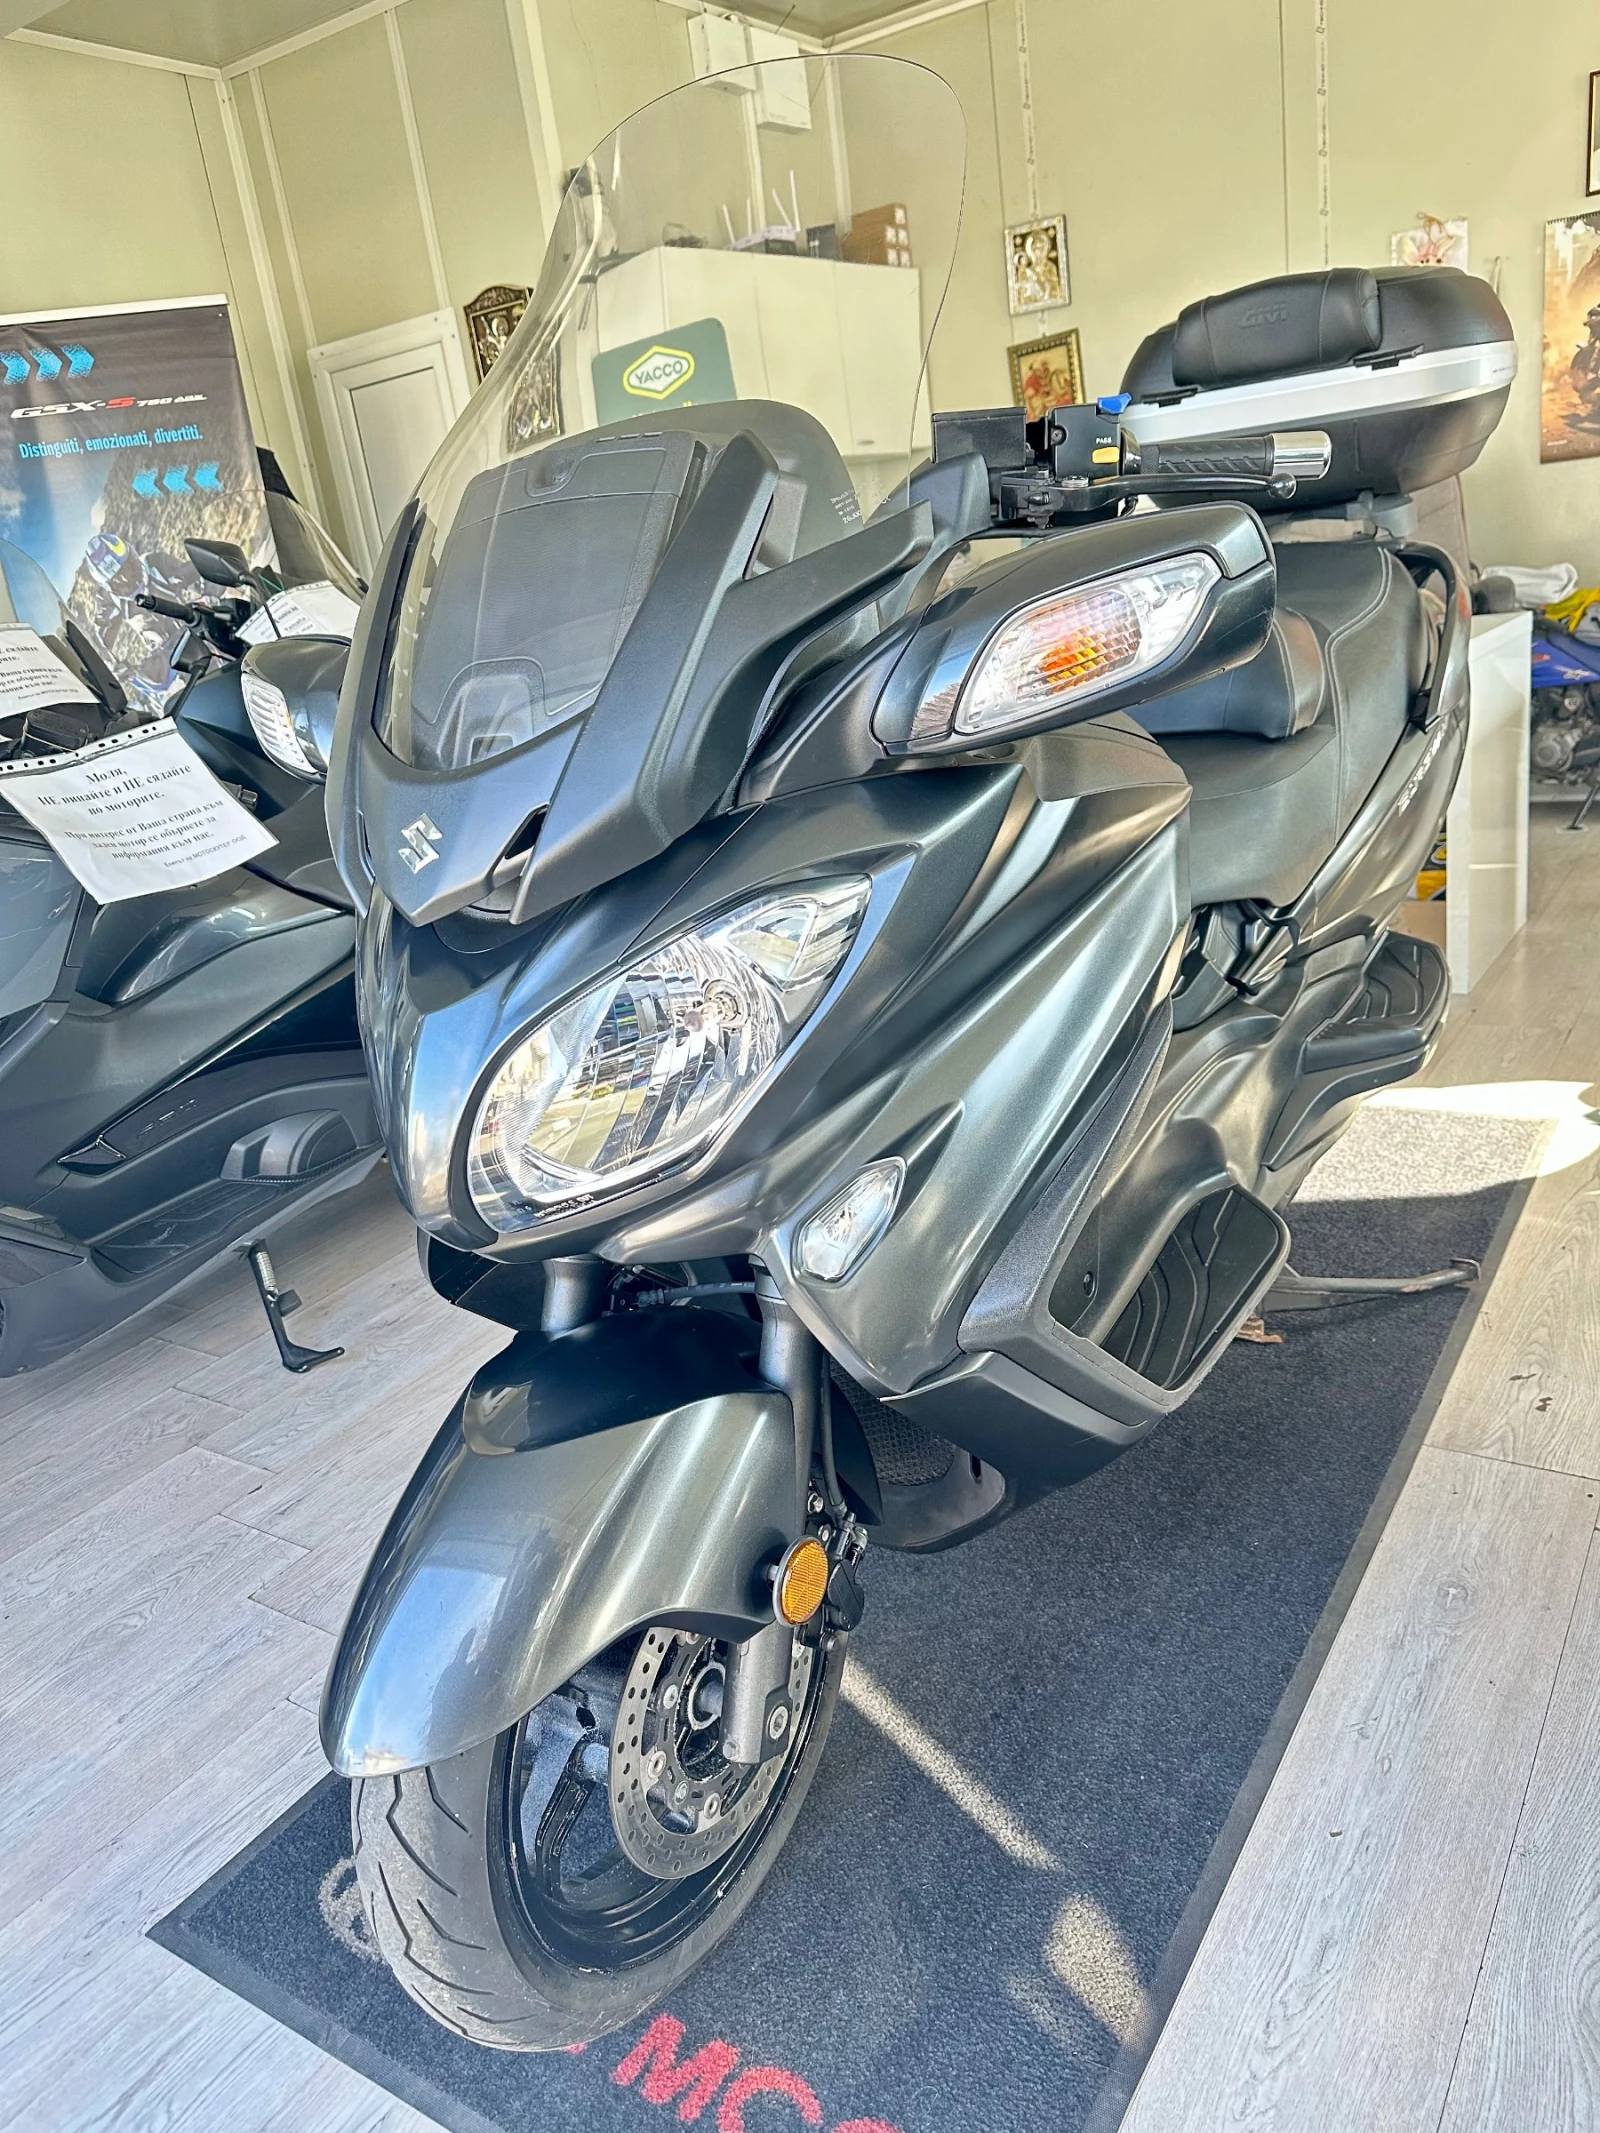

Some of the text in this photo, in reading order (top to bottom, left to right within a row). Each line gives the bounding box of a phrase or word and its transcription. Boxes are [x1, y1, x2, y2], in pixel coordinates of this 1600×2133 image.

[635, 360, 683, 385] YACCO
[10, 397, 136, 419] GSX-S
[19, 424, 204, 460] Distinguiti, emozionati, divertiti.
[1095, 436, 1112, 444] PASS
[38, 794, 62, 807] НЕ
[113, 785, 122, 795] и
[123, 776, 146, 792] НЕ
[146, 763, 193, 784] сядайте
[85, 767, 128, 785] Моля,
[88, 790, 165, 816] по моторите.
[125, 826, 138, 836] от
[137, 817, 168, 831] Ваша
[168, 806, 202, 826] страна
[148, 834, 160, 843] се
